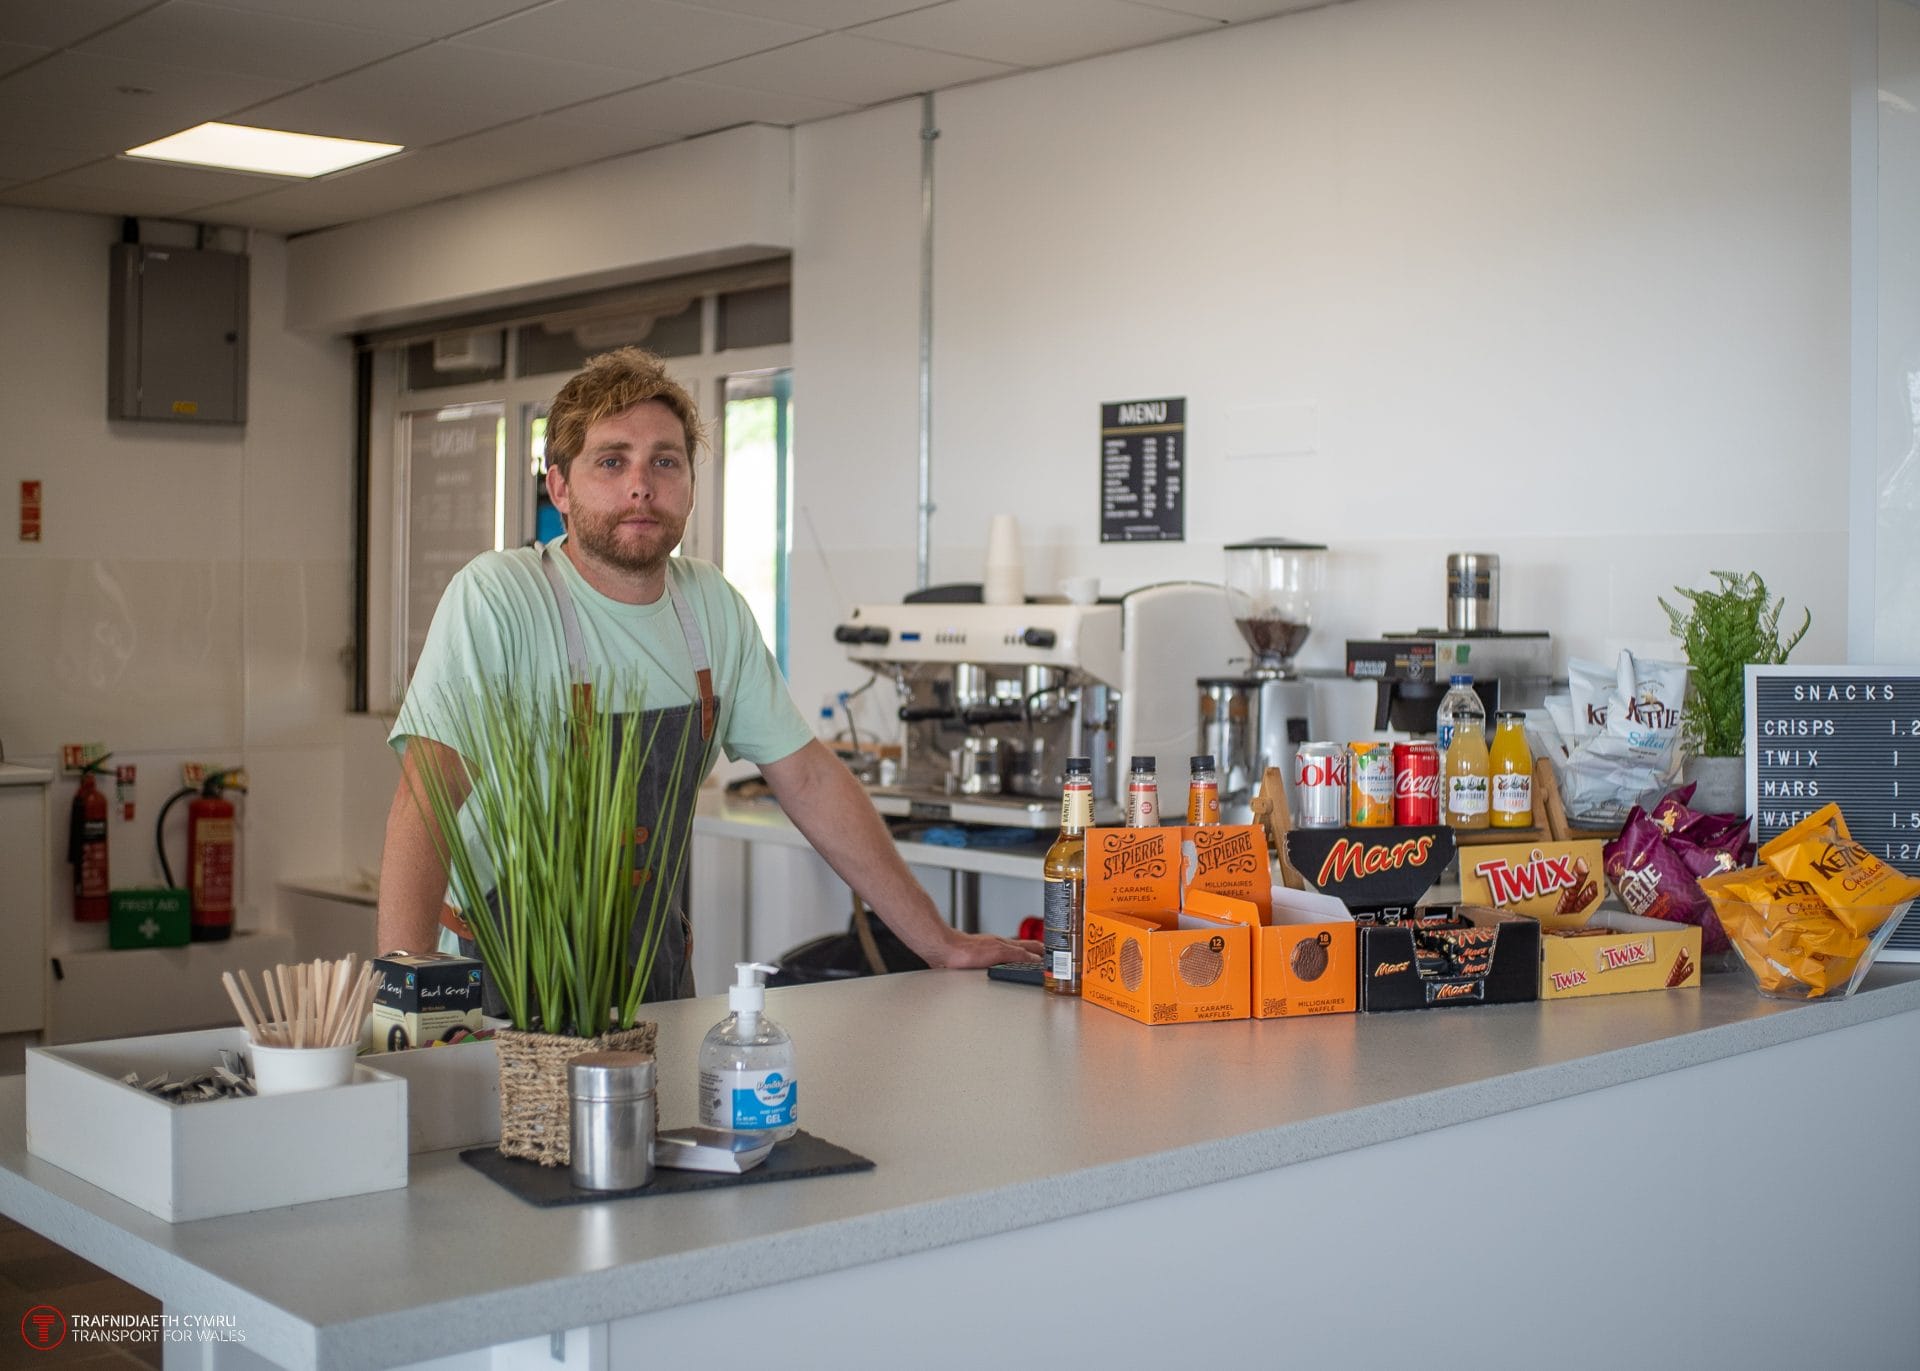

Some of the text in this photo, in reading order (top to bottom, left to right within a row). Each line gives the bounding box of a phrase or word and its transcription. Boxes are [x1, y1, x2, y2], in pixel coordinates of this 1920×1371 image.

[1118, 401, 1167, 424] MENU
[1794, 685, 1894, 700] SNACKS
[1625, 696, 1680, 729] KTTLE
[1764, 719, 1835, 735] CRISPS
[1765, 750, 1818, 766] TWIX
[1395, 768, 1440, 798] Coca-C
[1764, 780, 1819, 796] MARS
[1062, 793, 1071, 823] VANILLA
[1128, 793, 1136, 824] HAZELNUT
[1763, 811, 1812, 826] WAFF
[1317, 836, 1433, 886] Mars
[1205, 880, 1253, 888] MILLIONAIRES
[1476, 849, 1577, 907] Twix
[1773, 880, 1818, 900] KETT
[119, 898, 179, 912] FIRST AID
[1786, 902, 1829, 915] Chedd
[1604, 943, 1646, 969] Twix
[1374, 961, 1411, 977] Mars
[1551, 968, 1588, 991] Twix
[421, 985, 470, 999] Earl Grey
[1436, 983, 1474, 999] Mars
[1200, 1004, 1234, 1012] CARAMEL
[1298, 998, 1345, 1007] MILLIONAIRES
[1198, 1011, 1231, 1019] WAFFLES
[765, 1114, 781, 1124] GEL
